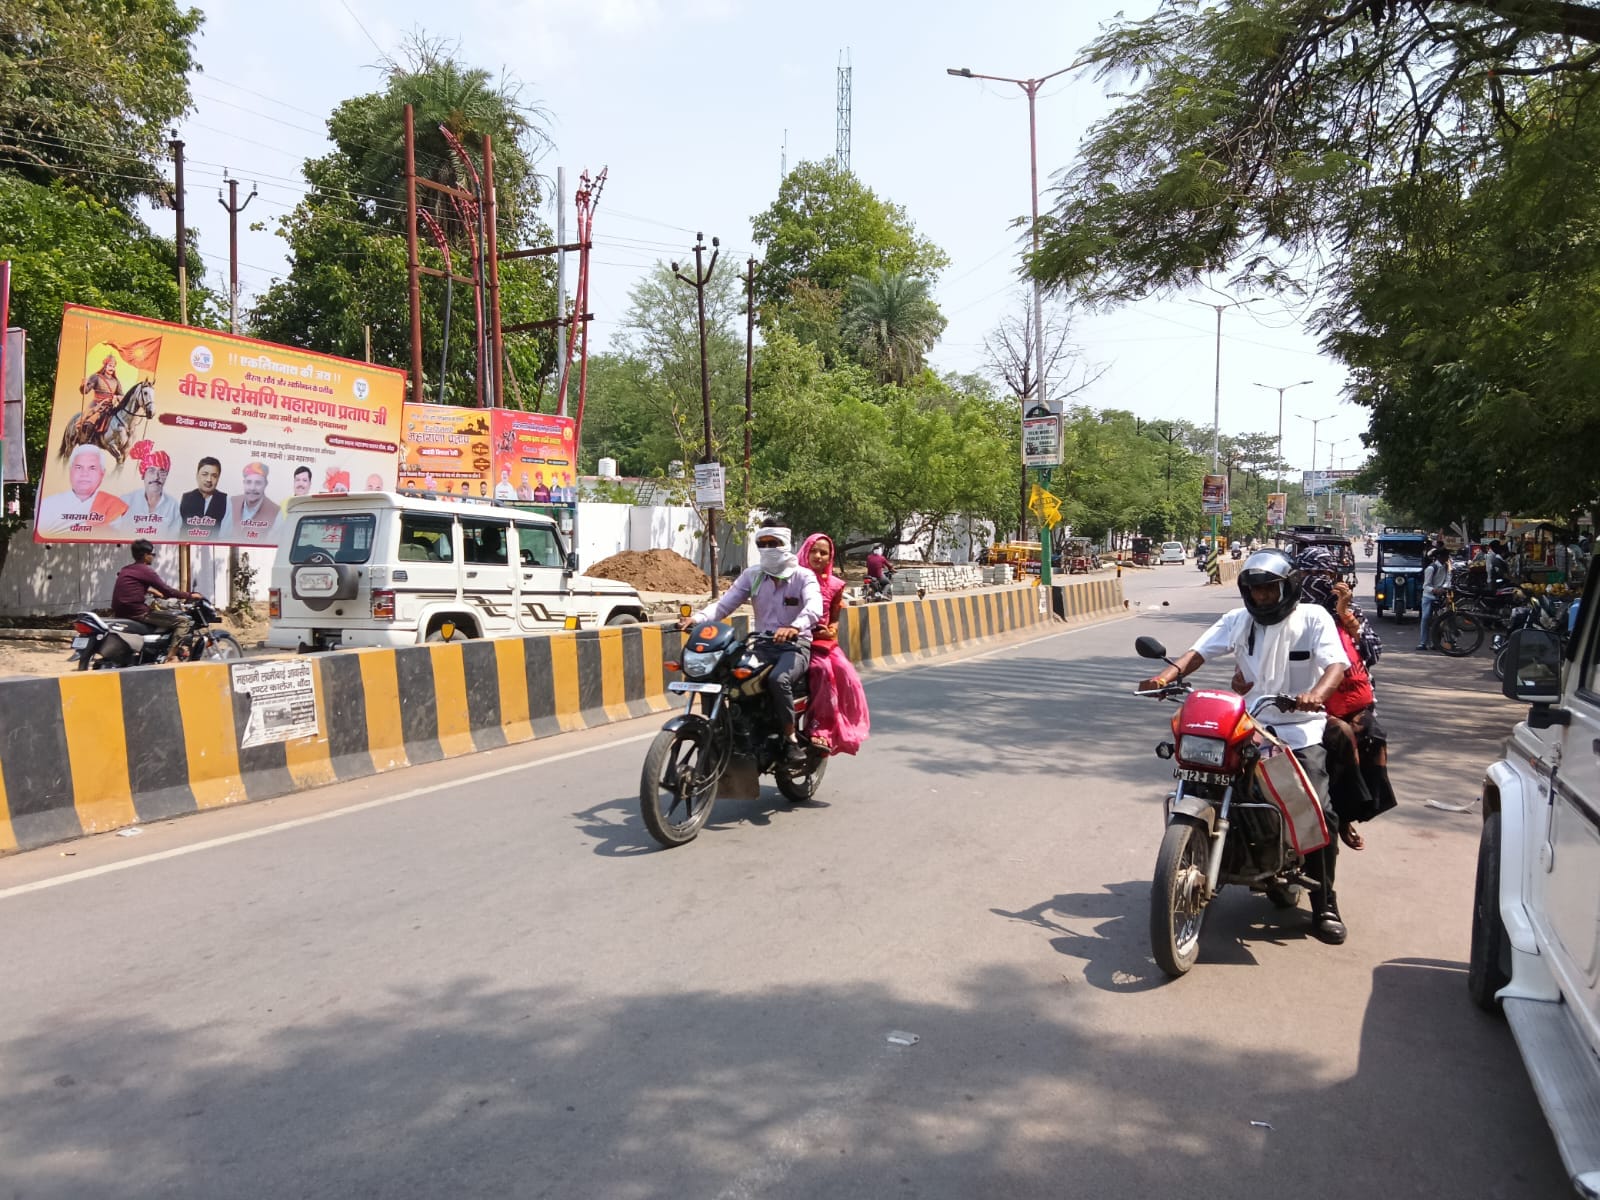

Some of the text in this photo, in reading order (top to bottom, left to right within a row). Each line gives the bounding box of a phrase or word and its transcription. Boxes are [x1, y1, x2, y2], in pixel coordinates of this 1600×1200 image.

[178, 373, 387, 426] वीर शिरोमणि महाराणा प्रताप जी
[232, 407, 241, 416] की
[259, 412, 267, 420] पर
[408, 432, 470, 445] महाराणा प्रताप
[134, 514, 148, 524] फूल
